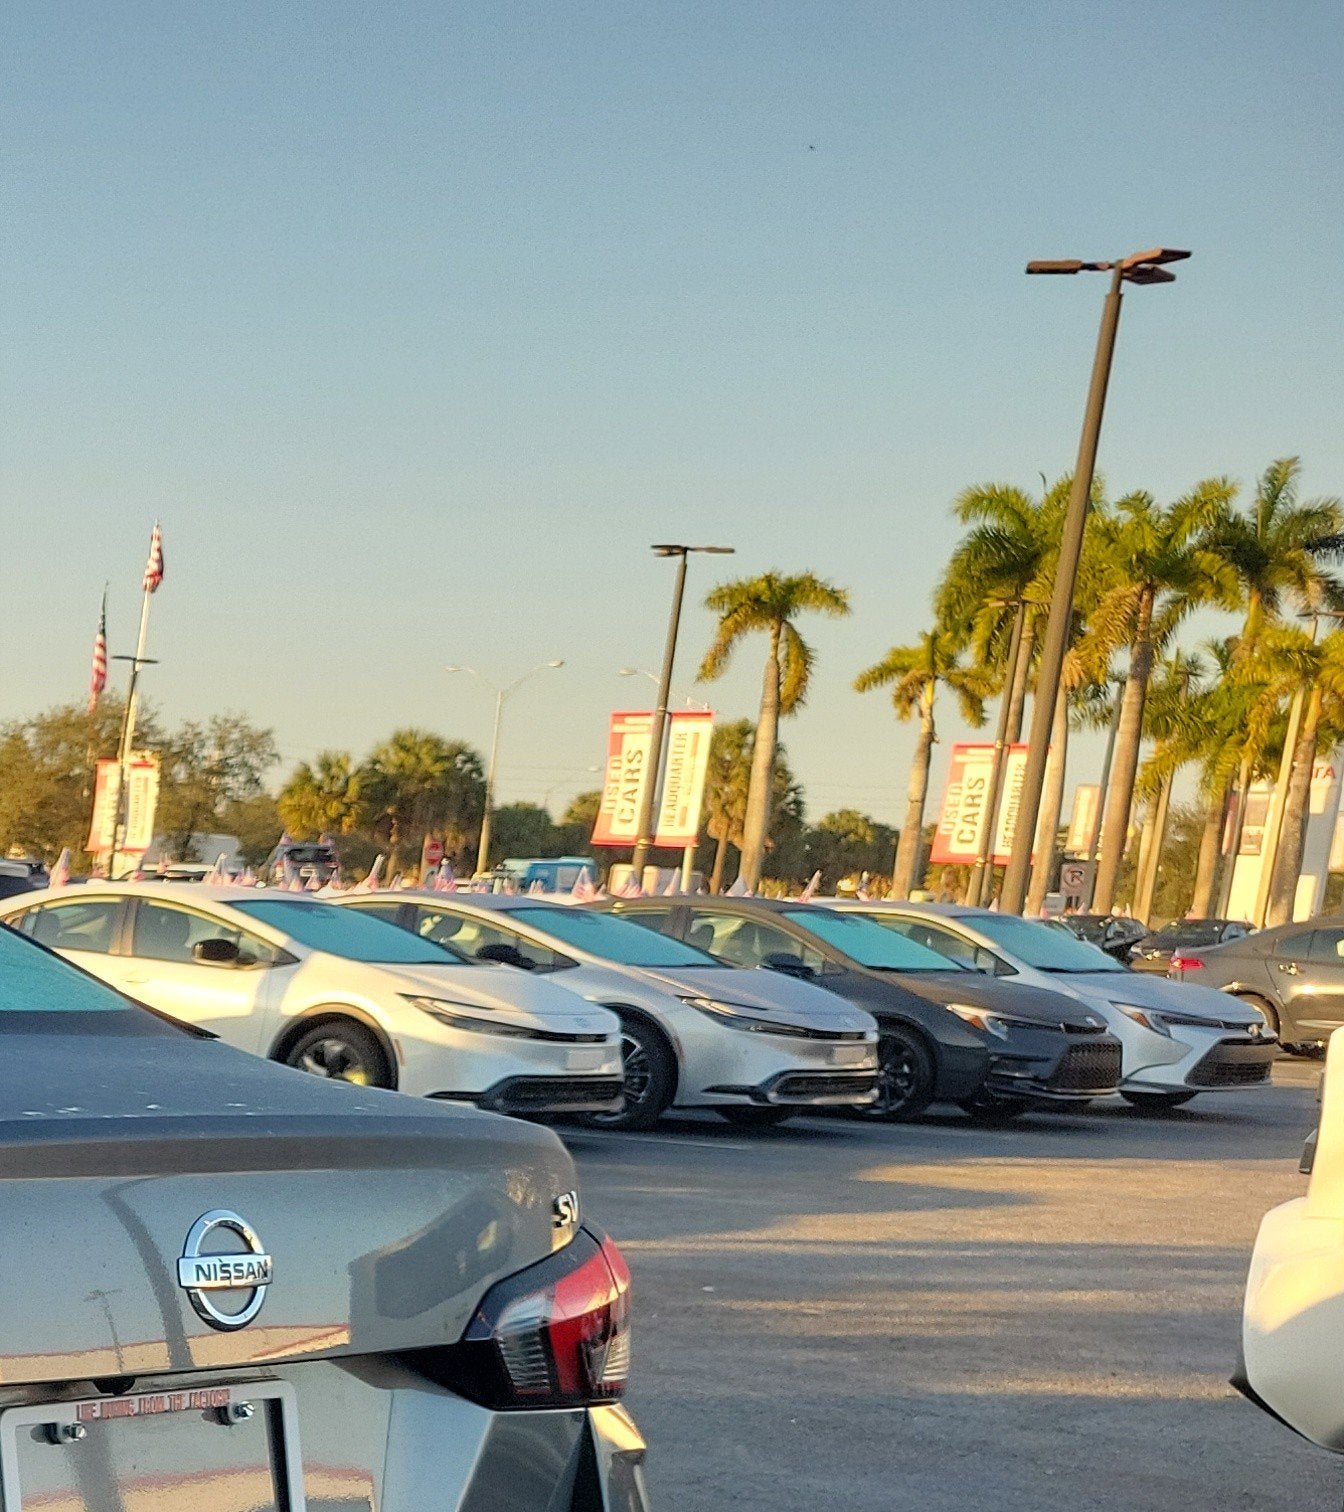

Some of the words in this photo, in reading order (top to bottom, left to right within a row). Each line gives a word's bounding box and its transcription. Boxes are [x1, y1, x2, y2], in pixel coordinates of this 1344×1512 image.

[605, 757, 622, 812] USED
[618, 749, 643, 824] CARS
[663, 732, 687, 828] HEADQUARTER
[943, 784, 963, 832] USED
[956, 776, 985, 845] CARS
[194, 1259, 269, 1281] NISSAN
